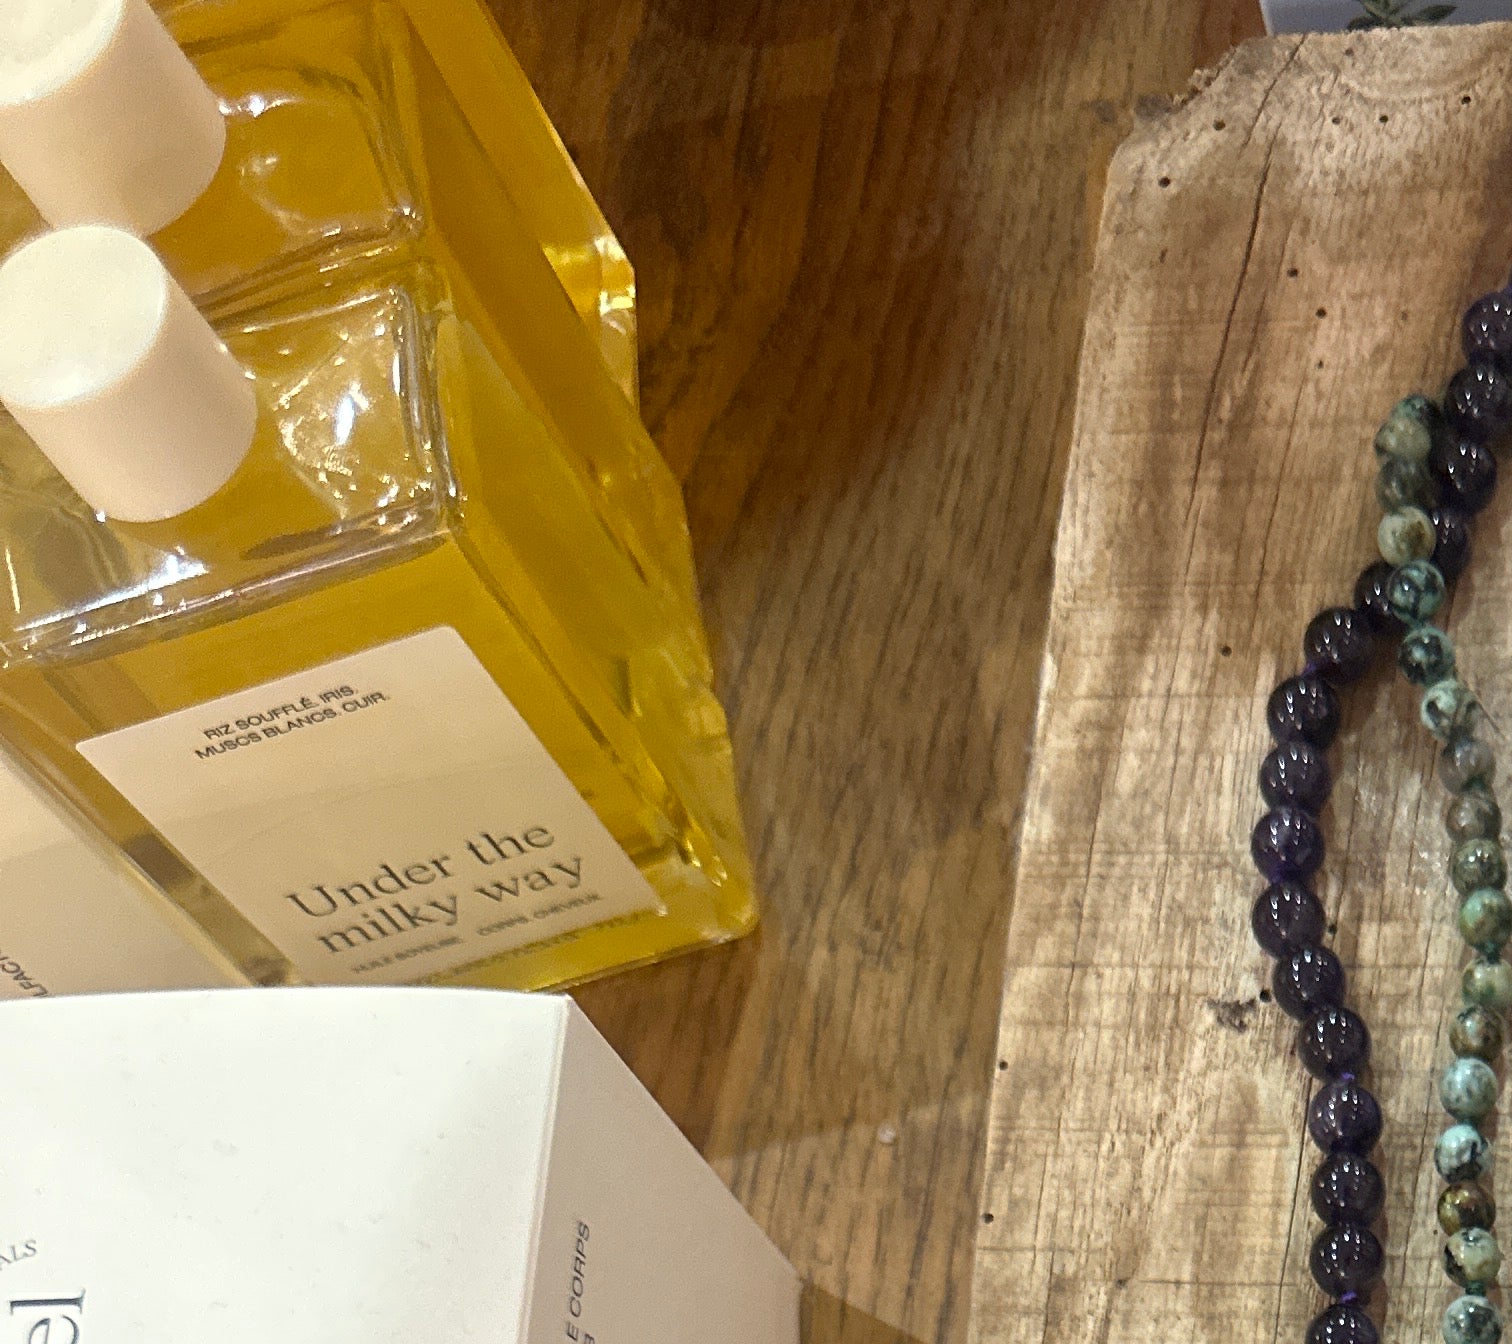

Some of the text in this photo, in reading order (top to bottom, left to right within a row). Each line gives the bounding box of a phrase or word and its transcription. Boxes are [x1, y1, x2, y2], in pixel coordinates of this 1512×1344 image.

[195, 733, 262, 759] MUSCS
[203, 723, 236, 740] RIZ
[286, 826, 554, 917] Under the
[317, 894, 459, 954] milky
[475, 856, 582, 902] way
[569, 1219, 590, 1318] CORPS
